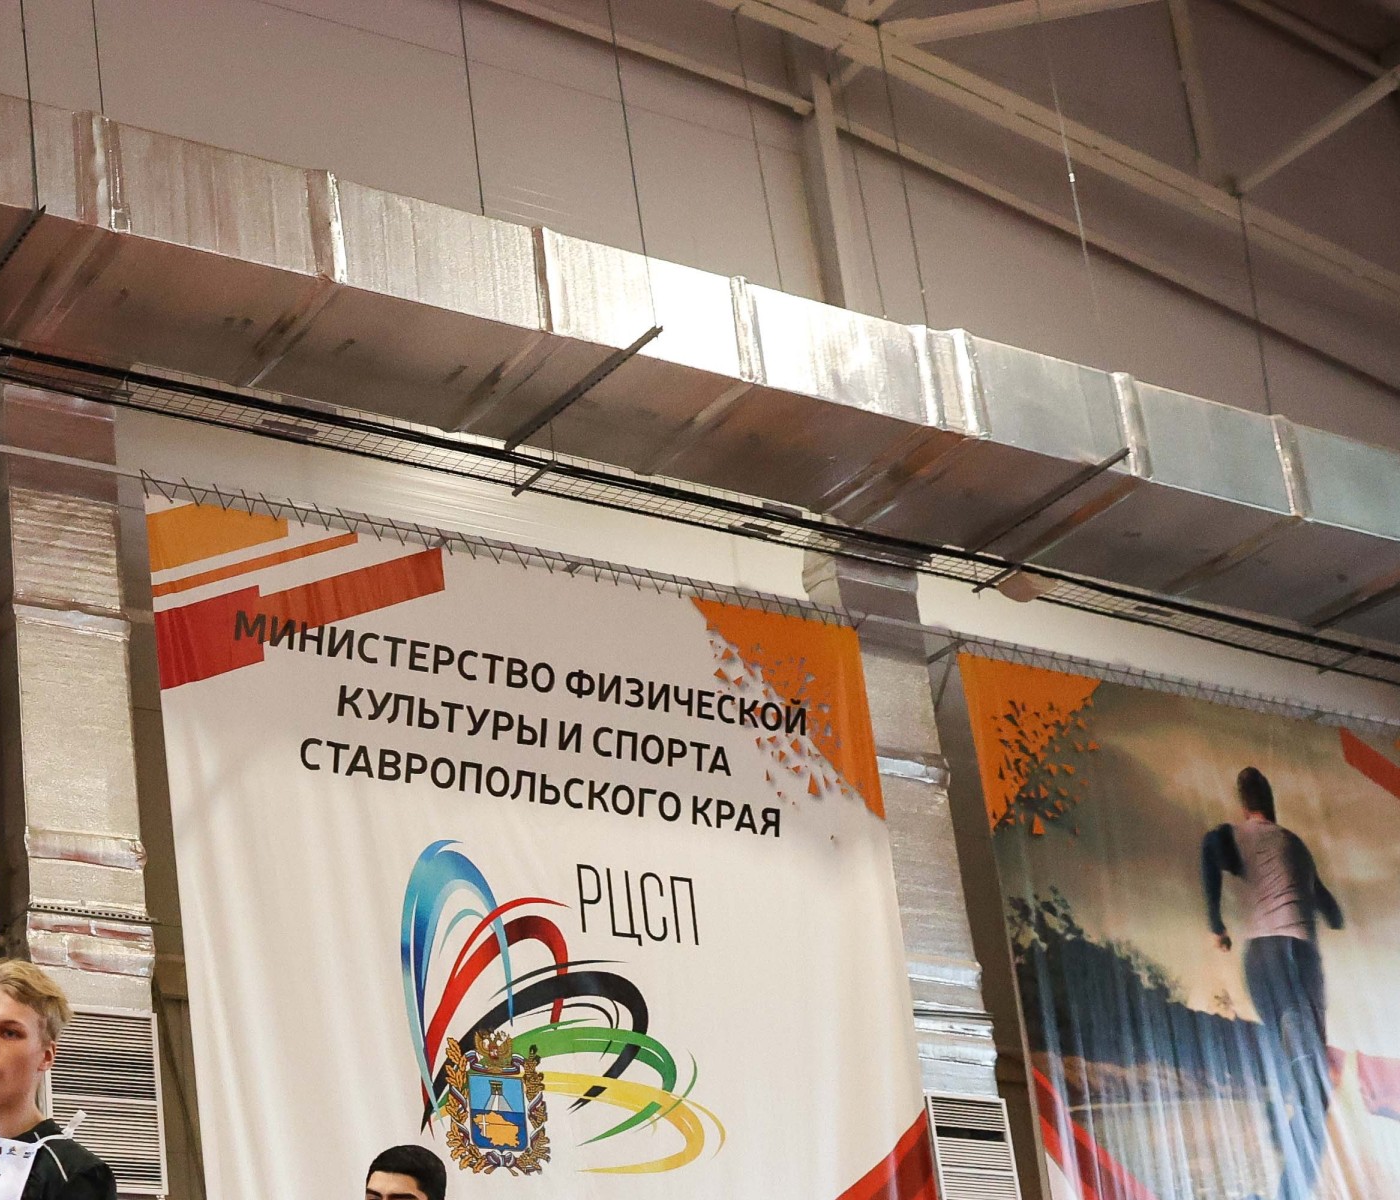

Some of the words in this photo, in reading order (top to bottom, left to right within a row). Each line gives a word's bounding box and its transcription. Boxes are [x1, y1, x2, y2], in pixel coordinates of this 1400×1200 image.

[234, 610, 555, 693] МИНИСТЕРСТВО
[565, 669, 807, 736] ФИЗИЧЕСКОЙ
[337, 684, 548, 748] КУЛЬТУРЫ
[558, 720, 583, 754] И
[592, 726, 732, 777] СПОРТА
[300, 737, 682, 822] СТАВРОПОЛЬСКОГО
[691, 795, 781, 838] КРАЯ
[576, 863, 699, 947] РЦСП
